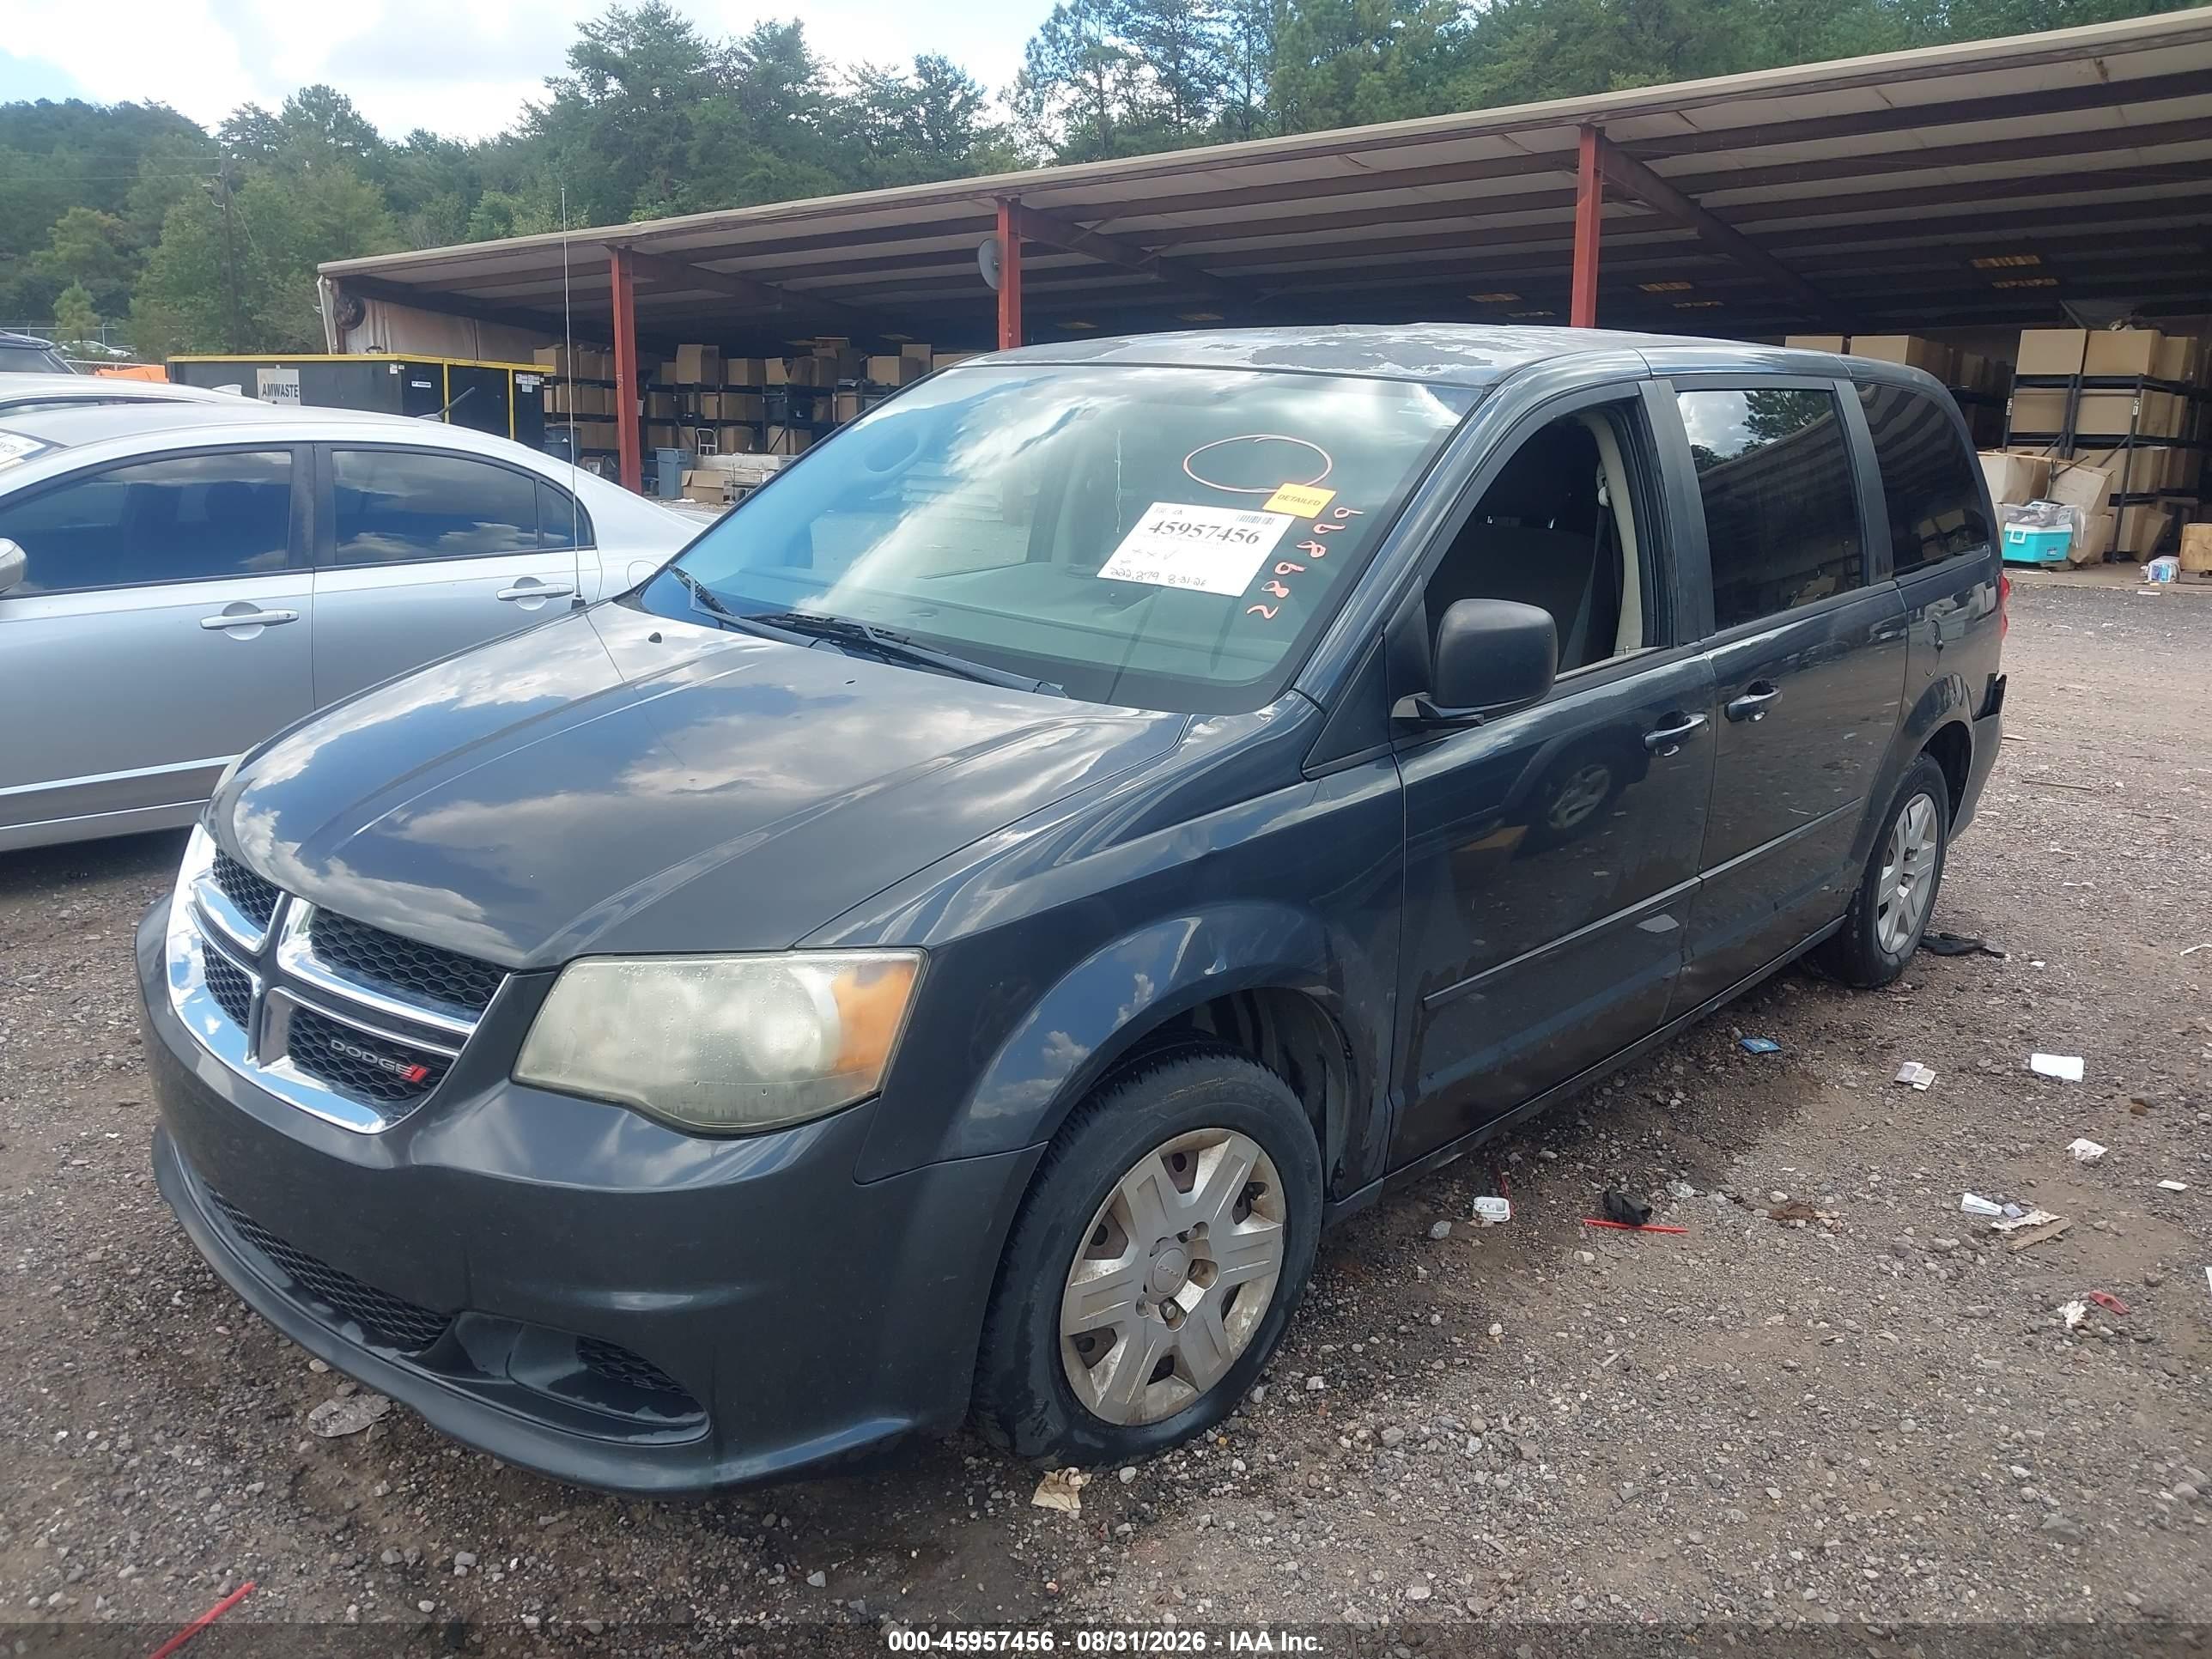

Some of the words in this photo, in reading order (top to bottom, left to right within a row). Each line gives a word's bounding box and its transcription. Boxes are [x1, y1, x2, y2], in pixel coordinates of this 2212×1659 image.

[261, 383, 299, 398] AMWASTE
[1277, 494, 1321, 506] DETAILED
[1148, 520, 1263, 544] 45957456
[330, 1039, 412, 1078] DODGE
